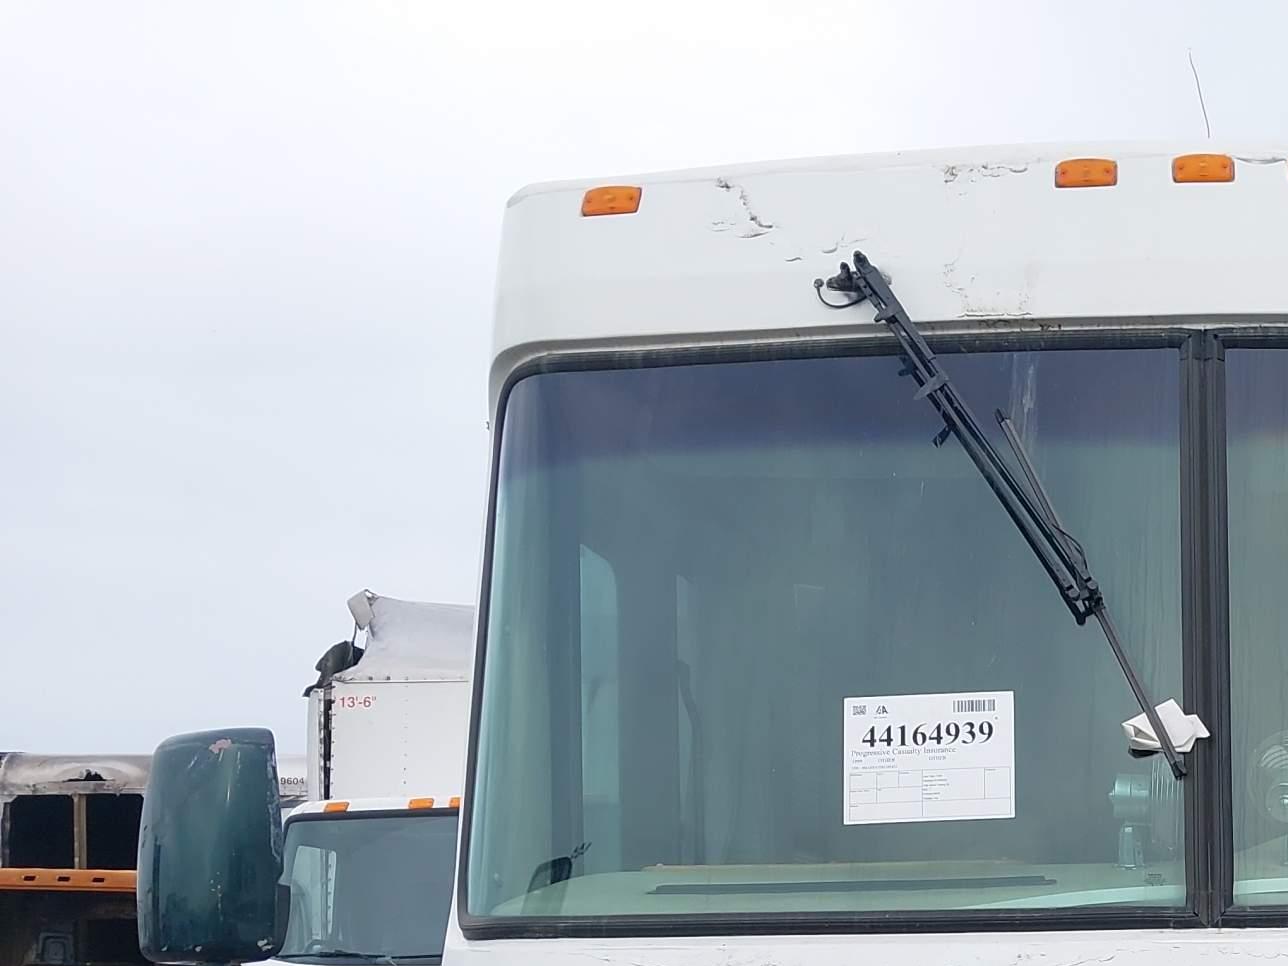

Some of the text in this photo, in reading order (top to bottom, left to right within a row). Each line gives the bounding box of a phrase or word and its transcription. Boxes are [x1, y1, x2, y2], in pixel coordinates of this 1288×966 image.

[340, 696, 377, 708] 13'-6"
[862, 720, 994, 747] 44164939
[851, 746, 957, 758] Progressive Casualty Insurance
[280, 777, 305, 786] 9604
